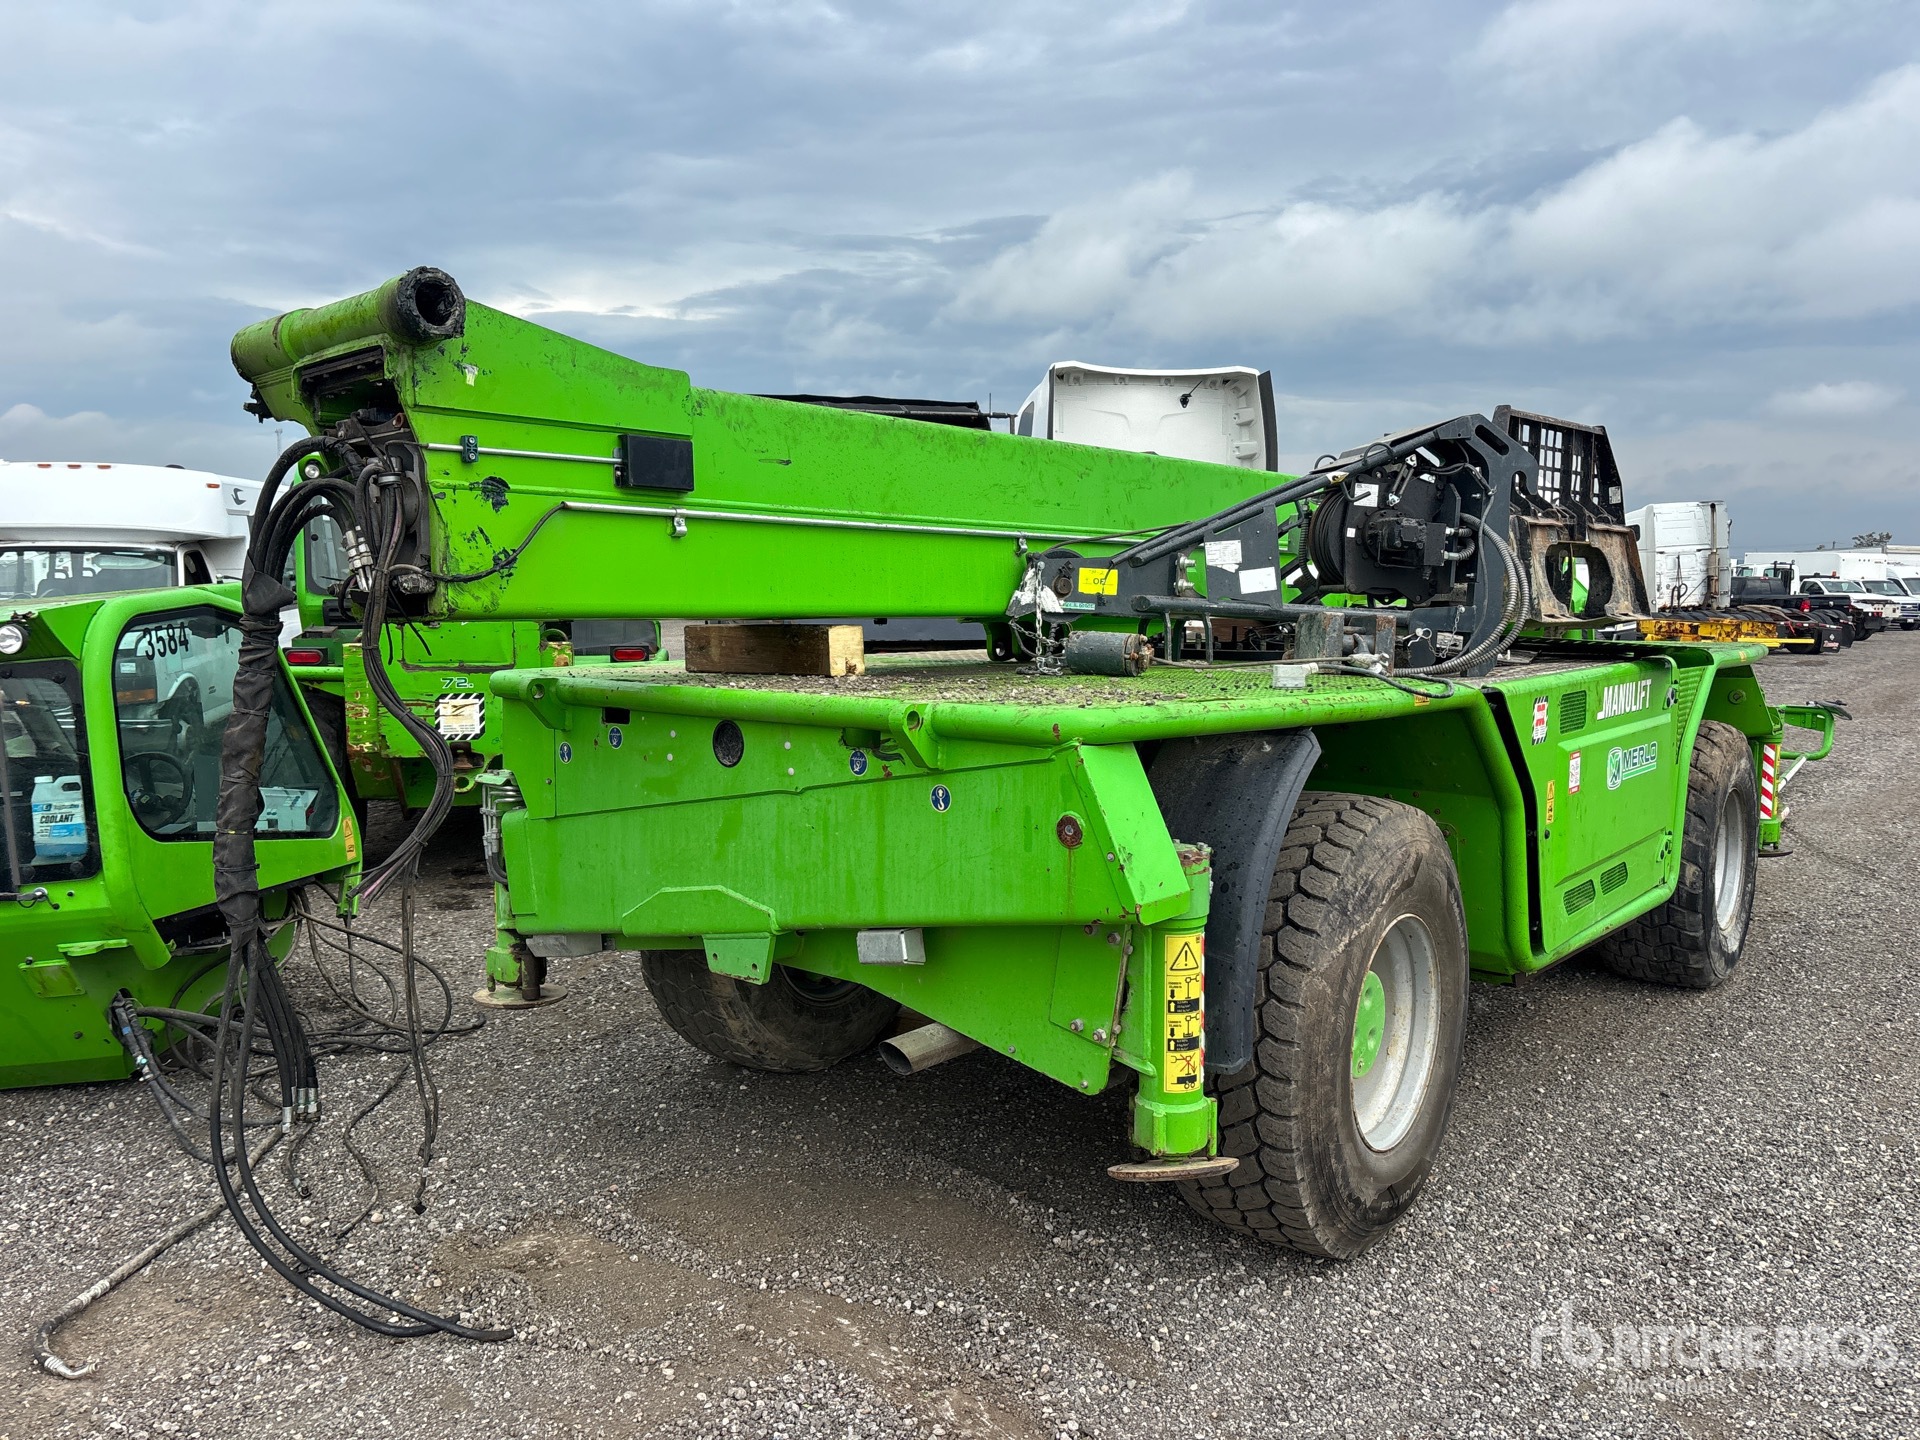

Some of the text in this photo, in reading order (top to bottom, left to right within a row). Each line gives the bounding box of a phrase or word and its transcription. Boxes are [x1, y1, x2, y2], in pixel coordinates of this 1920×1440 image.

[143, 622, 189, 660] 3584
[1597, 679, 1652, 720] MANULIFT
[1622, 741, 1658, 772] MERLO
[39, 813, 75, 824] COOLANT
